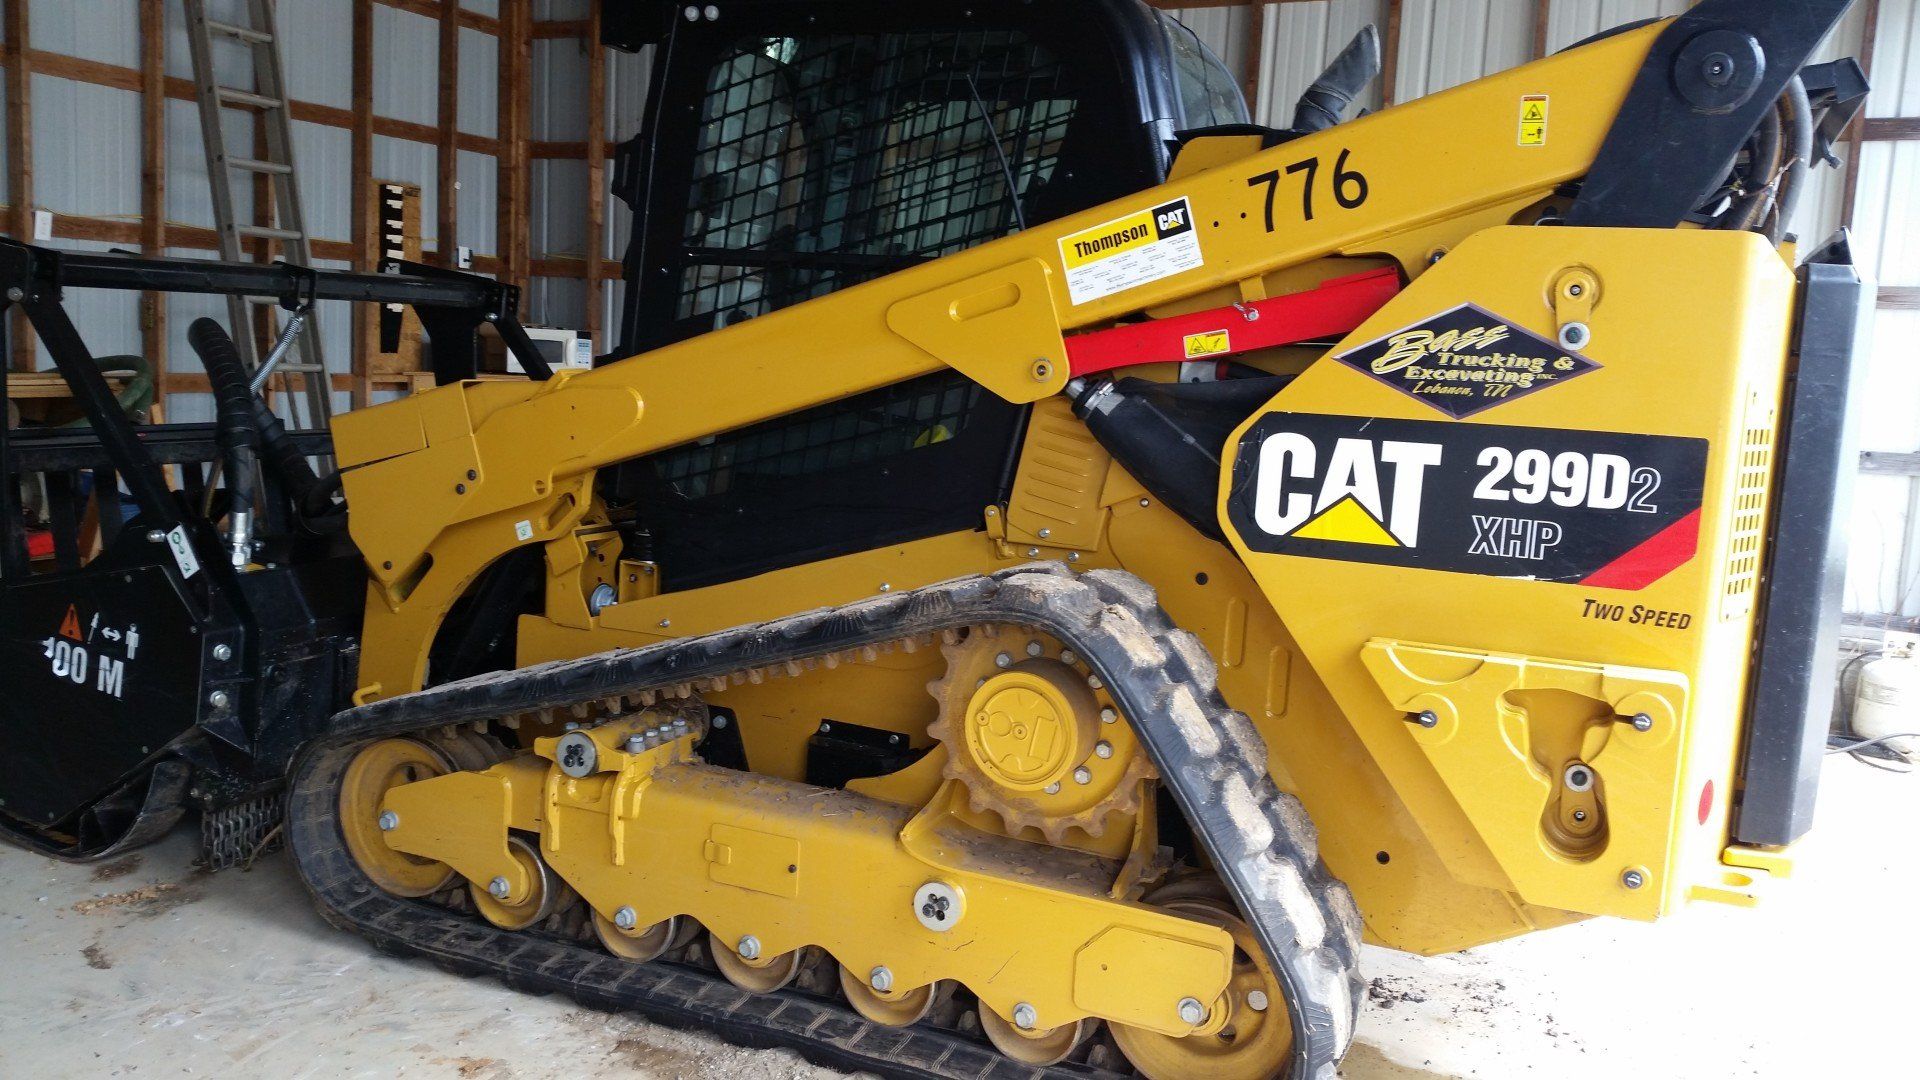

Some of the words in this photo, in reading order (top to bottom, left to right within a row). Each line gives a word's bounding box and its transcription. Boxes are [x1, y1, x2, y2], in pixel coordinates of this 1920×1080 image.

[1247, 148, 1369, 233] 776
[1074, 223, 1149, 258] Thompson
[1157, 207, 1186, 231] CAT
[1371, 324, 1510, 375] Bass
[1437, 352, 1548, 374] Trucking
[1553, 356, 1575, 371] &
[1404, 365, 1535, 388] Excavating
[1412, 381, 1474, 397] Lebanon,
[1483, 383, 1514, 398] TN
[1254, 432, 1443, 548] CAT
[1467, 515, 1563, 561] XHP
[1580, 598, 1625, 623] TWO
[1628, 603, 1692, 630] SPEED
[97, 655, 124, 698] M
